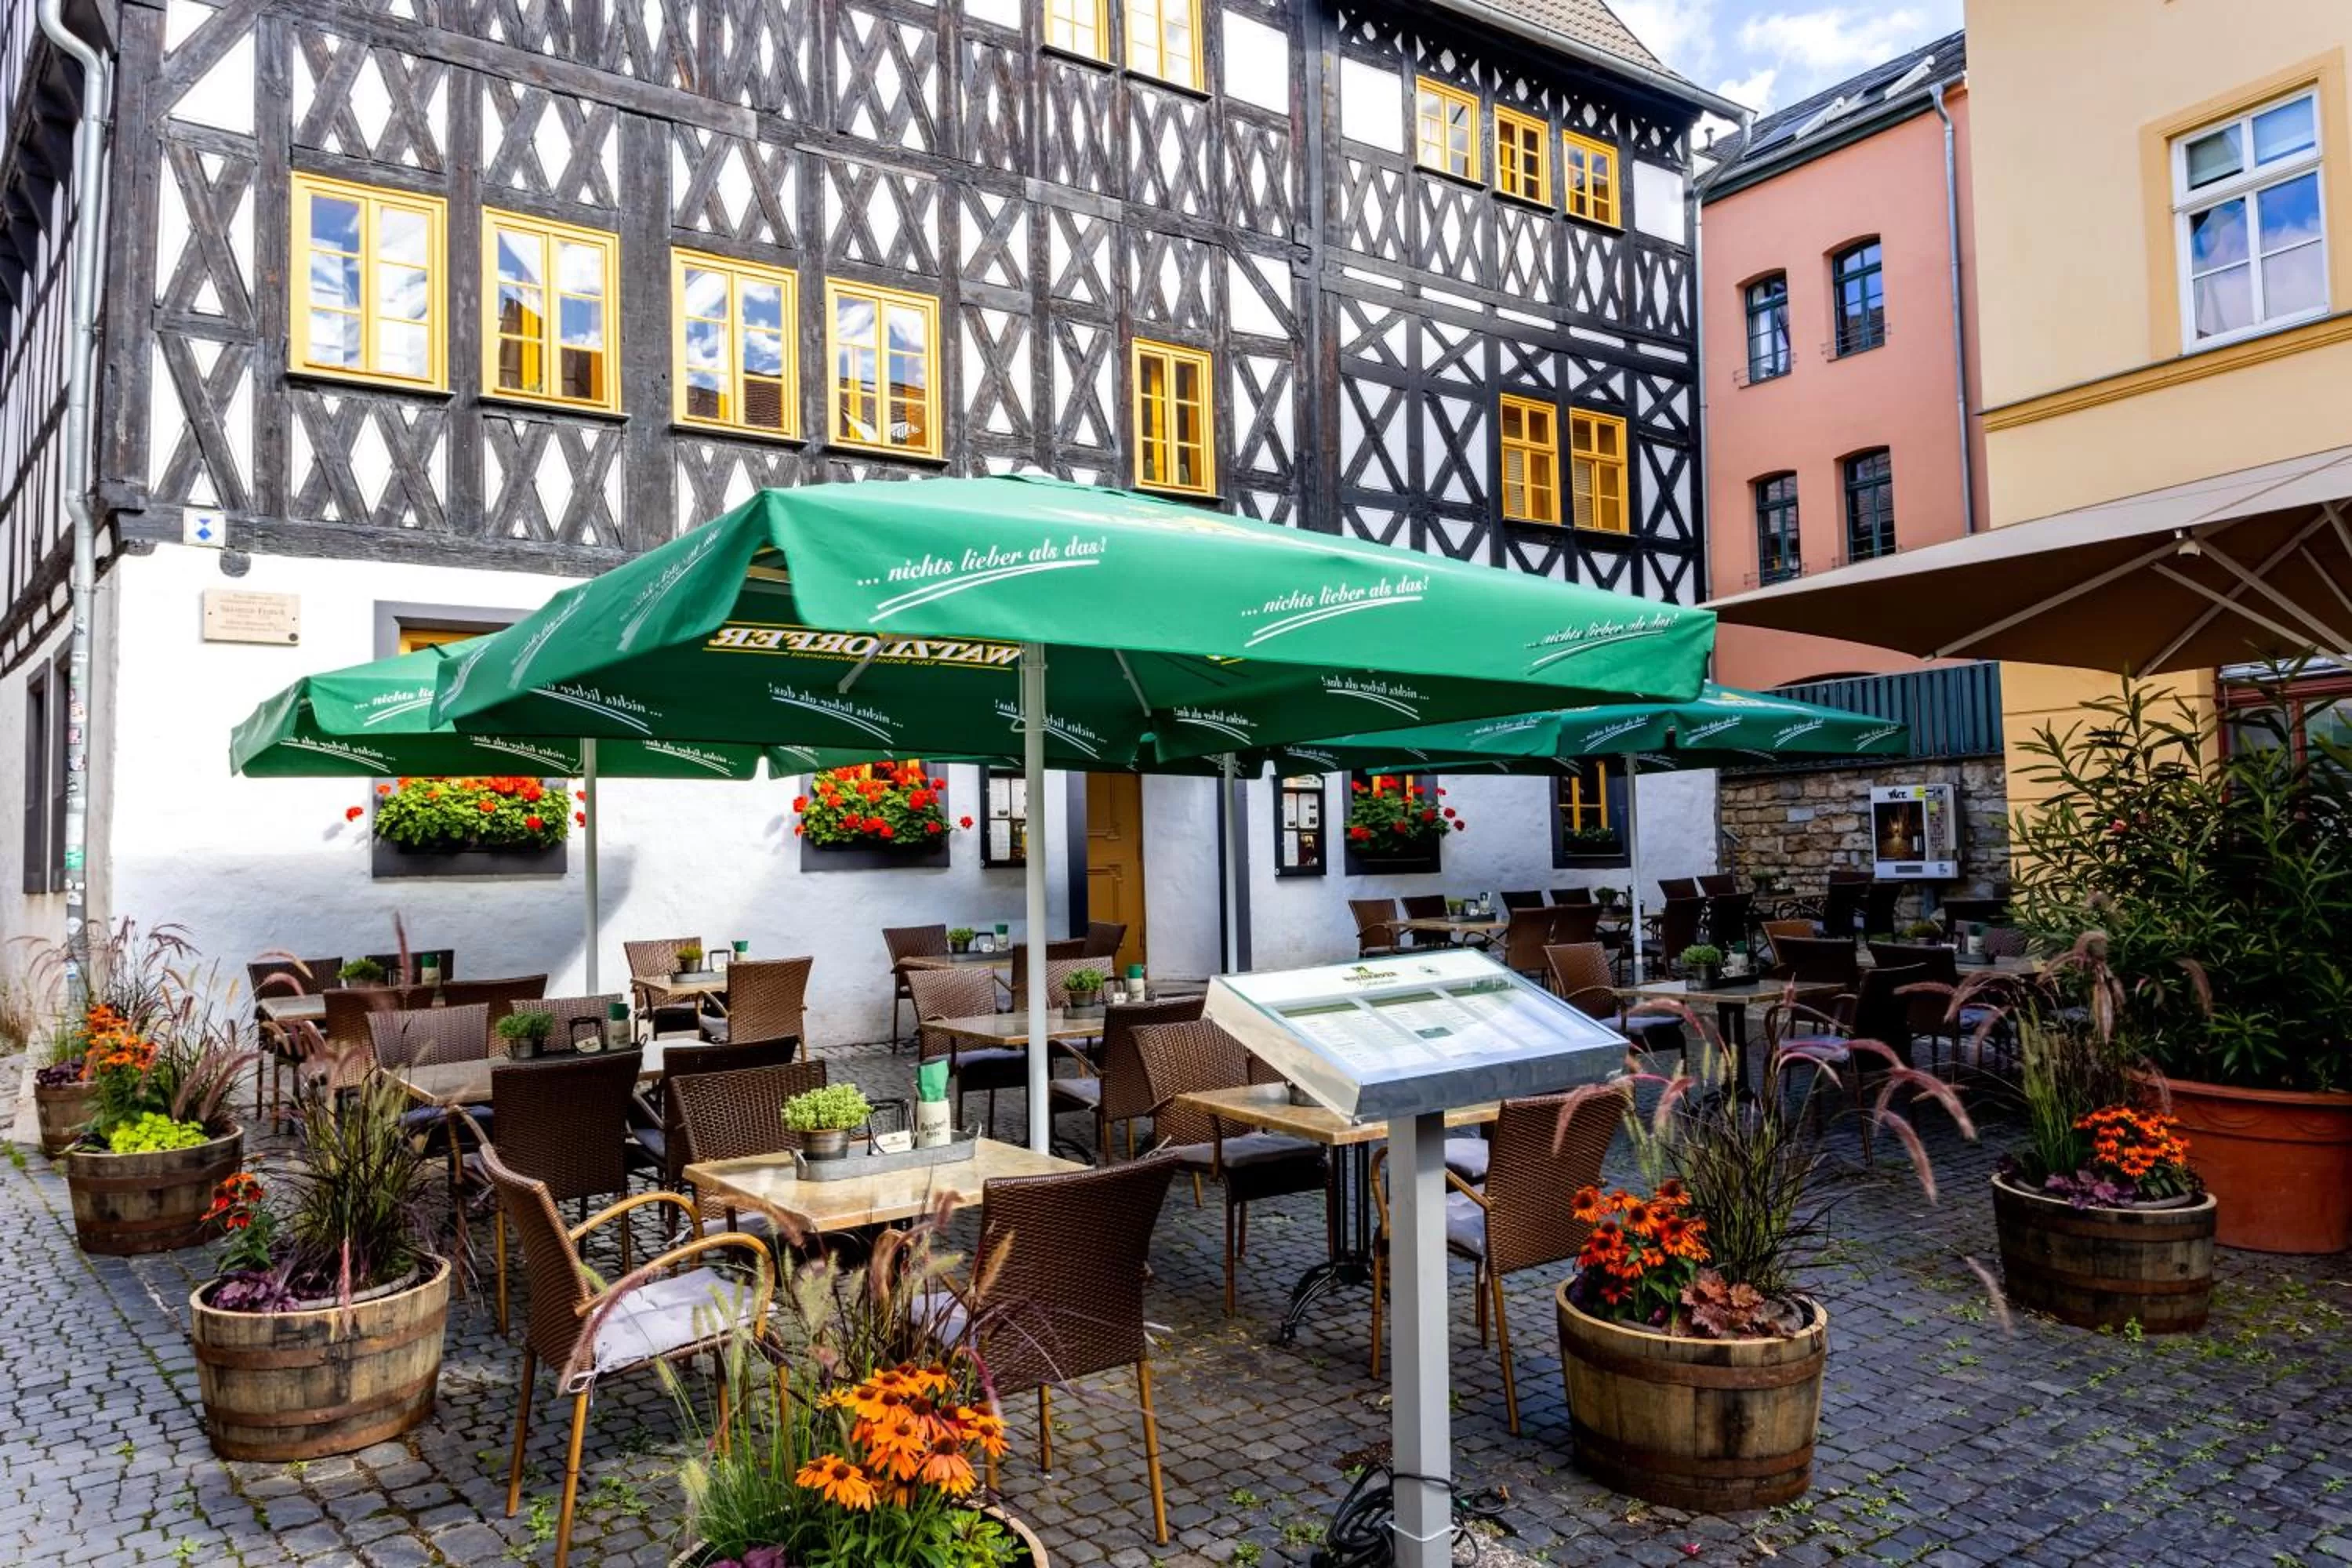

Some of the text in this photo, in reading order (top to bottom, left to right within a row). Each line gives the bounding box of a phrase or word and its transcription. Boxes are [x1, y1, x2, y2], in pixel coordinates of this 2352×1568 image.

[887, 554, 954, 582] nichts
[960, 545, 1024, 572] lieber
[1028, 539, 1058, 561] als
[1064, 535, 1107, 557] das!
[1263, 590, 1315, 614] nichts
[1319, 583, 1366, 606] lieber
[1369, 577, 1392, 597] als
[1396, 575, 1430, 594] das!
[372, 691, 414, 706] nichts
